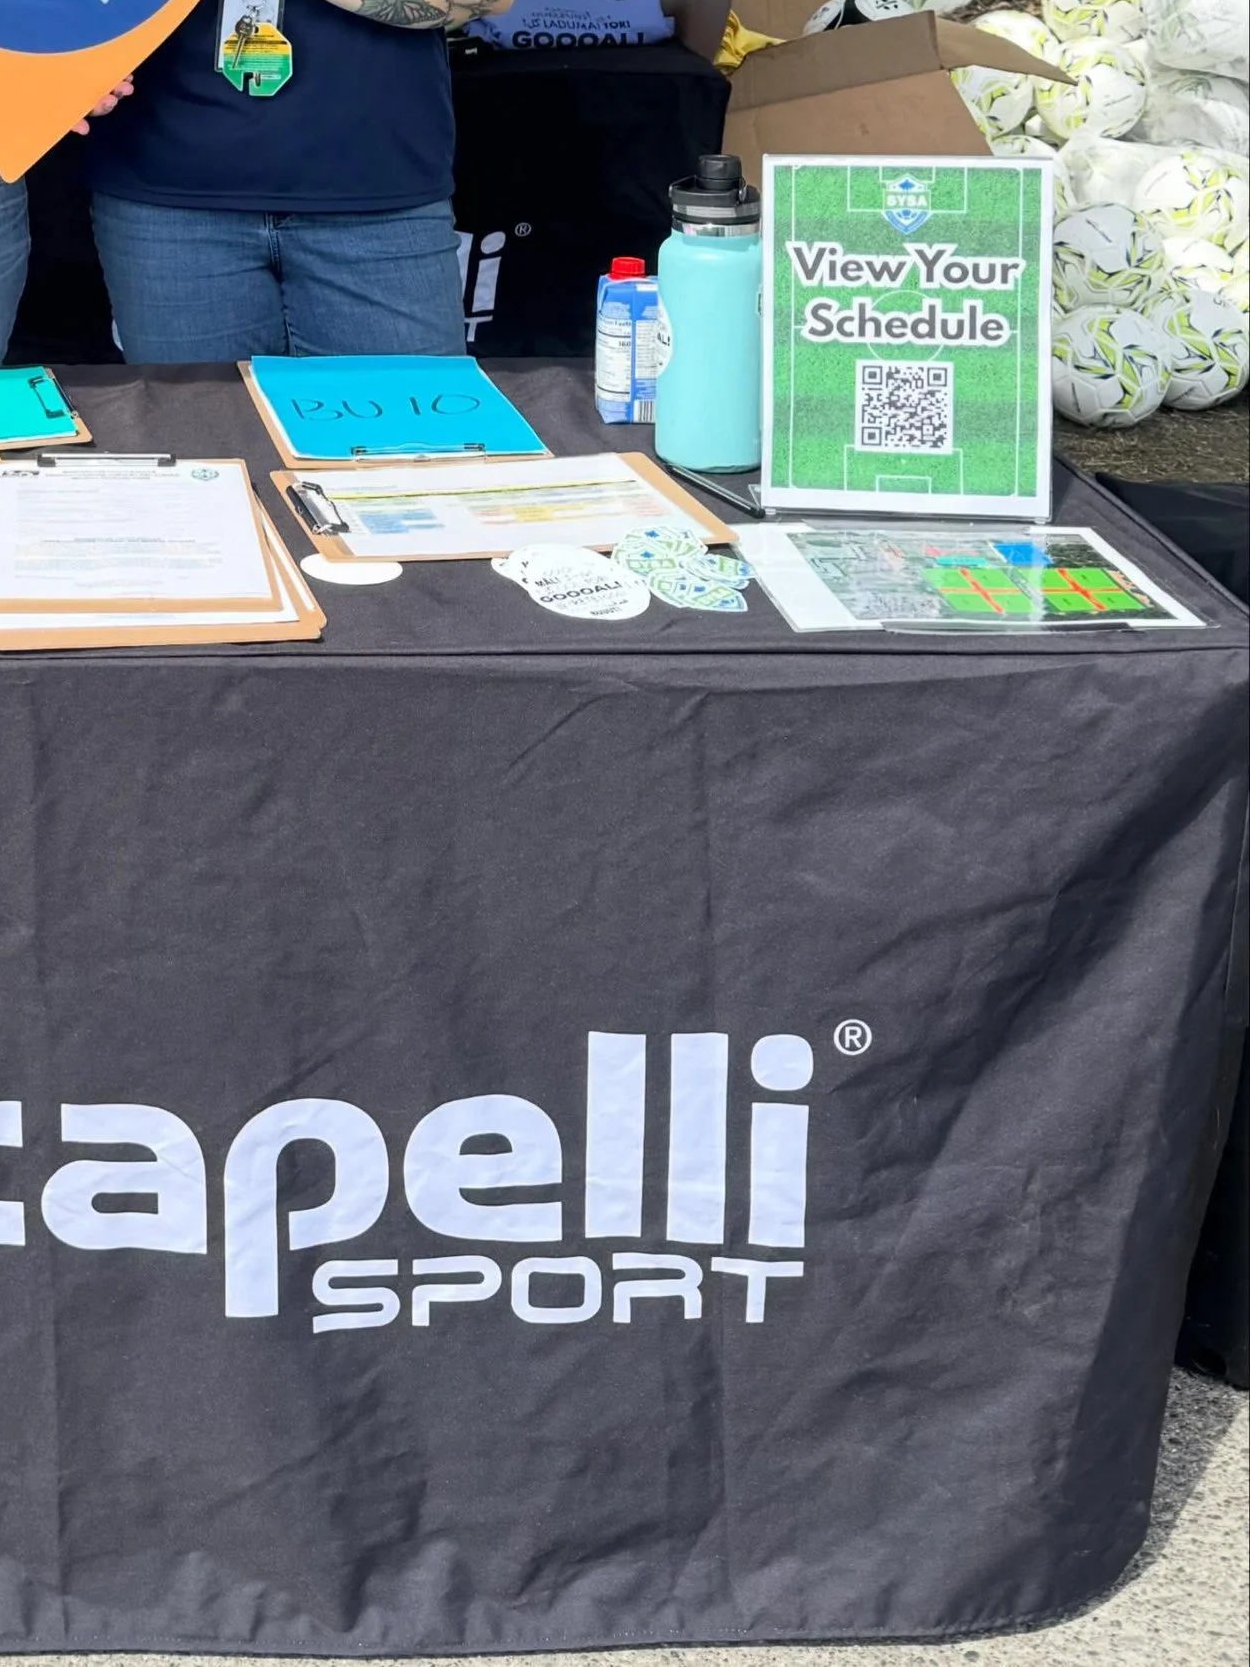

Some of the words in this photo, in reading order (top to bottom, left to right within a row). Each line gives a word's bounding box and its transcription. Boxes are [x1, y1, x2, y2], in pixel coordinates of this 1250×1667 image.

[887, 195, 928, 207] SYSA
[793, 245, 907, 284] View
[915, 247, 1020, 286] Your
[807, 302, 1005, 342] Schedule
[291, 398, 384, 422] BU
[409, 393, 481, 416] 10
[540, 579, 623, 604] GOOOAL!
[311, 1253, 805, 1334] SPORT
